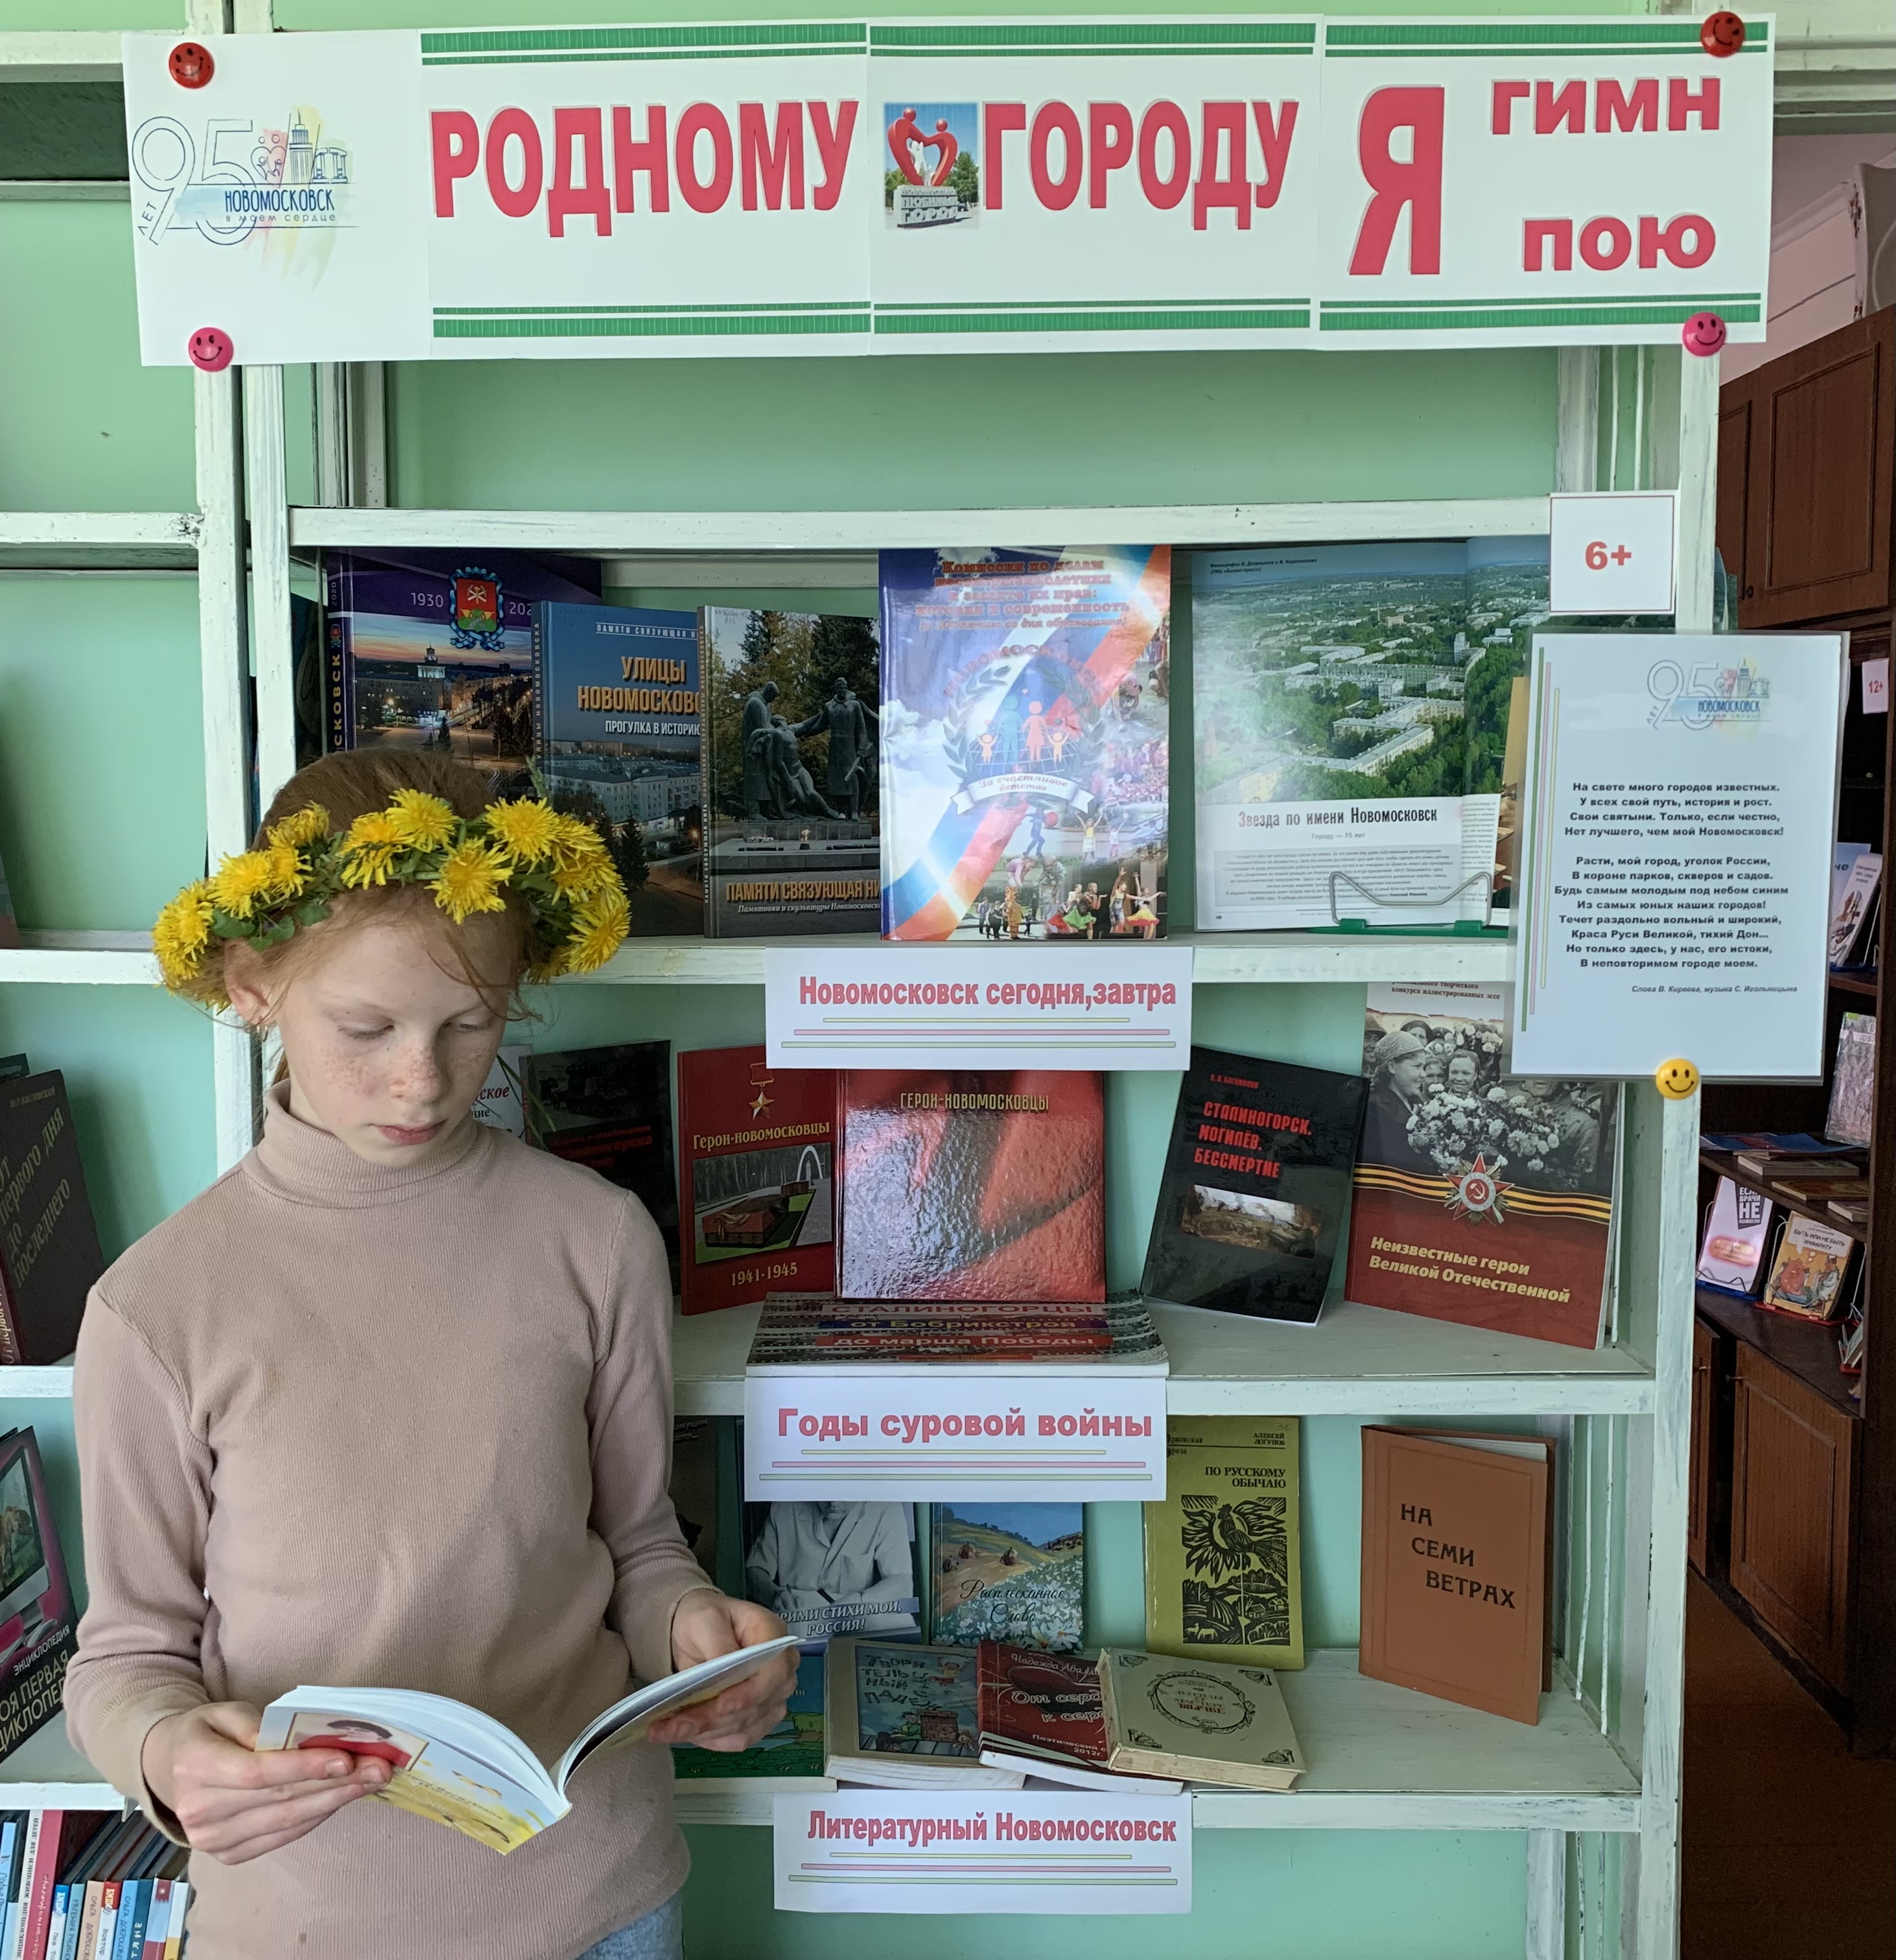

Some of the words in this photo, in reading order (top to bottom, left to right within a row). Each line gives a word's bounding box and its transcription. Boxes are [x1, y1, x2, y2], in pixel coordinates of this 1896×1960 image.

[428, 99, 860, 238] РОДНОМУ
[982, 98, 1300, 231] ГОРОДУ
[1347, 83, 1445, 275] Я
[224, 189, 336, 213] НОВОМОСКОВСК
[285, 213, 336, 224] сердце
[1585, 541, 1632, 570] 6+
[411, 592, 445, 609] 1930
[620, 656, 686, 685] УЛИЦЫ
[1698, 699, 1761, 713] НОВОМОСКОВСК
[605, 720, 652, 734] ПРОГУЛКА
[653, 722, 660, 734] В
[1572, 782, 1589, 792] На
[1591, 784, 1626, 792] свете
[1628, 784, 1665, 792] много
[1667, 784, 1713, 794] городов
[1715, 784, 1781, 792] известных.
[1579, 797, 1588, 807] У
[1589, 799, 1619, 807] всех
[1621, 795, 1650, 807] свой
[1652, 799, 1682, 809] путь,
[1684, 799, 1731, 809] история
[1733, 799, 1741, 807] и
[1742, 799, 1773, 809] рост.
[1286, 813, 1301, 828] по
[1306, 810, 1344, 826] имени
[1569, 811, 1600, 822] Свои
[1602, 813, 1657, 822] святыни.
[1658, 811, 1705, 823] Только,
[1706, 813, 1736, 822] если
[1737, 813, 1781, 823] честно,
[1563, 826, 1587, 837] Нет
[1588, 828, 1644, 839] лучшего,
[1646, 828, 1670, 837] чем
[1672, 824, 1696, 837] мой
[1698, 826, 1785, 837] Новомосковск!
[1575, 856, 1615, 868] Расти,
[1617, 854, 1642, 866] мой
[1644, 858, 1681, 868] город,
[1683, 858, 1724, 868] уголок
[1725, 856, 1772, 867] России,
[1571, 870, 1581, 880] В
[1583, 872, 1627, 882] короне
[1629, 872, 1675, 883] парков,
[1676, 872, 1724, 883] скверов
[1726, 872, 1735, 881] и
[1736, 872, 1774, 881] садов.
[726, 882, 780, 902] ПАМЯТИ
[782, 880, 864, 900] СВЯЗУЮЩАЯ
[1554, 885, 1584, 897] Будь
[1585, 887, 1628, 895] самым
[1630, 887, 1687, 896] молодым
[1689, 887, 1711, 897] под
[1713, 885, 1750, 895] небом
[1751, 887, 1790, 895] синим
[1576, 900, 1593, 910] Из
[1595, 902, 1637, 910] самых
[1639, 902, 1674, 910] юных
[1676, 902, 1716, 910] наших
[1717, 900, 1767, 912] городов!
[1558, 914, 1594, 924] Течет
[1595, 916, 1661, 926] раздольно
[1663, 915, 1715, 925] вольный
[1727, 912, 1783, 926] широкий,
[1571, 929, 1608, 941] Краса
[1610, 929, 1640, 941] Руси
[1642, 927, 1698, 940] Великой,
[1699, 929, 1734, 939] тихий
[1565, 943, 1583, 953] Но
[1585, 945, 1626, 954] только
[1628, 946, 1668, 955] здесь,
[1669, 946, 1678, 956] у
[1679, 946, 1705, 955] нас,
[1707, 946, 1727, 954] его
[1729, 945, 1773, 955] истоки,
[1579, 958, 1589, 968] В
[1591, 960, 1679, 970] неповторимом
[1681, 960, 1722, 970] городе
[1723, 960, 1759, 968] моем.
[799, 975, 979, 1005] Новомосковск
[985, 981, 1176, 1012] сегодня,завтра
[1391, 986, 1422, 996] конкурса
[900, 1093, 1049, 1112] ГЕРОИ-НОВОМОСКОВЦЫ
[1203, 1101, 1313, 1136] СТАЛИНОГОРСК.
[692, 1121, 831, 1152] Герои-новомосковцы
[1197, 1124, 1263, 1152] МОГИЛЁВ.
[1193, 1147, 1281, 1180] БЕССМЕРТИЕ
[1739, 1202, 1761, 1219] НЕ
[1370, 1235, 1478, 1268] Неизвестные
[1480, 1257, 1530, 1277] герои
[731, 1261, 799, 1287] 1941-1945
[1369, 1254, 1440, 1280] Великой
[1442, 1268, 1571, 1304] Отечественной
[830, 1304, 1095, 1316] СТАЛИНОГОРЦЫ
[832, 1336, 881, 1348] до
[889, 1336, 972, 1348] марша
[981, 1335, 1094, 1347] Победы
[778, 1408, 869, 1443] Годы
[880, 1407, 1027, 1444] суровой
[1037, 1407, 1153, 1438] войны
[1204, 1465, 1221, 1476] ПО
[1224, 1467, 1287, 1478] РУССКОМУ
[1231, 1478, 1287, 1489] ОБЫЧАЮ
[1400, 1502, 1433, 1528] НА
[1410, 1536, 1475, 1568] СЕМИ
[1425, 1569, 1516, 1610] ВЕТРАХ
[821, 1603, 865, 1619] СТИХИ
[865, 1600, 902, 1614] МОИ,
[806, 1618, 866, 1637] РОССИЯ!
[13, 1624, 71, 1676] ЭНЦИКЛОПЕДИЯ
[1011, 1690, 1051, 1705] От
[1032, 1733, 1099, 1751] Поэтический
[1073, 1747, 1104, 1758] 2012г.
[807, 1810, 988, 1848] Литературный
[996, 1812, 1177, 1842] Новомосковск
[16, 1902, 29, 1959] ЭНЦИКЛОПЕДИЯ
[23, 1858, 34, 1899] ЖИВОПИСИ
